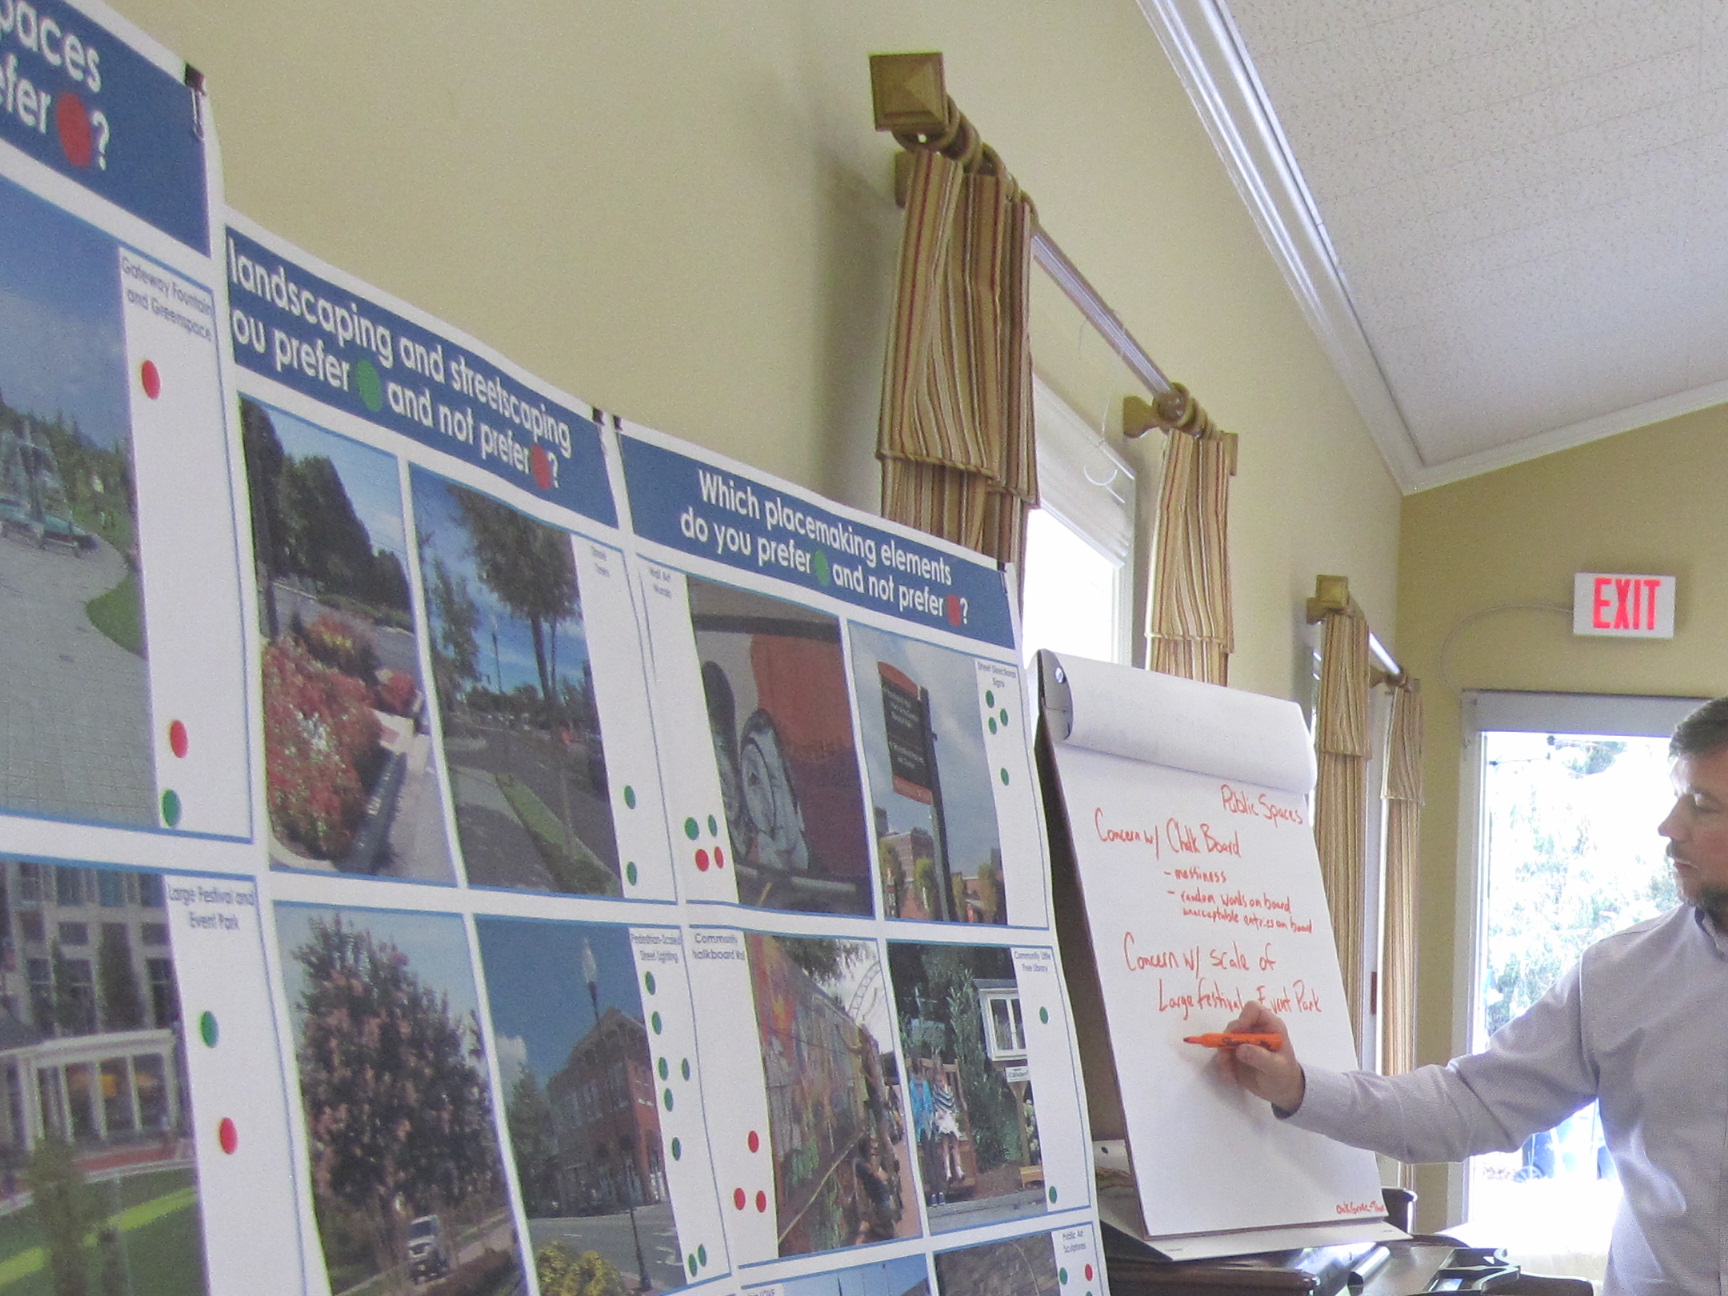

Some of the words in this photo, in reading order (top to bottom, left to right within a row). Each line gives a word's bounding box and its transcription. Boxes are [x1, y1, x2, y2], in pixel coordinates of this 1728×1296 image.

[228, 237, 395, 369] landscaping
[400, 336, 446, 385] and
[451, 355, 572, 459] streetscaping
[273, 327, 350, 393] prefer
[387, 381, 434, 428] and
[438, 403, 475, 446] not
[479, 422, 529, 475] prefer
[698, 469, 760, 519] Which
[765, 497, 877, 568] placemaking
[881, 540, 952, 585] elements
[681, 505, 709, 542] do
[713, 522, 751, 555] you
[757, 536, 811, 574] prefer
[833, 563, 865, 593] and
[868, 575, 894, 601] not
[898, 584, 943, 616] prefer
[1593, 577, 1661, 630] EXIT
[1095, 807, 1141, 842] Concern
[1166, 818, 1200, 853] Chalk
[1200, 823, 1241, 858] Board
[1221, 784, 1258, 815] Public
[1258, 793, 1303, 828] Spaces
[1124, 932, 1179, 971] Concern
[1259, 942, 1276, 971] of
[1159, 979, 1194, 1020] Large
[1292, 979, 1322, 1013] Park
